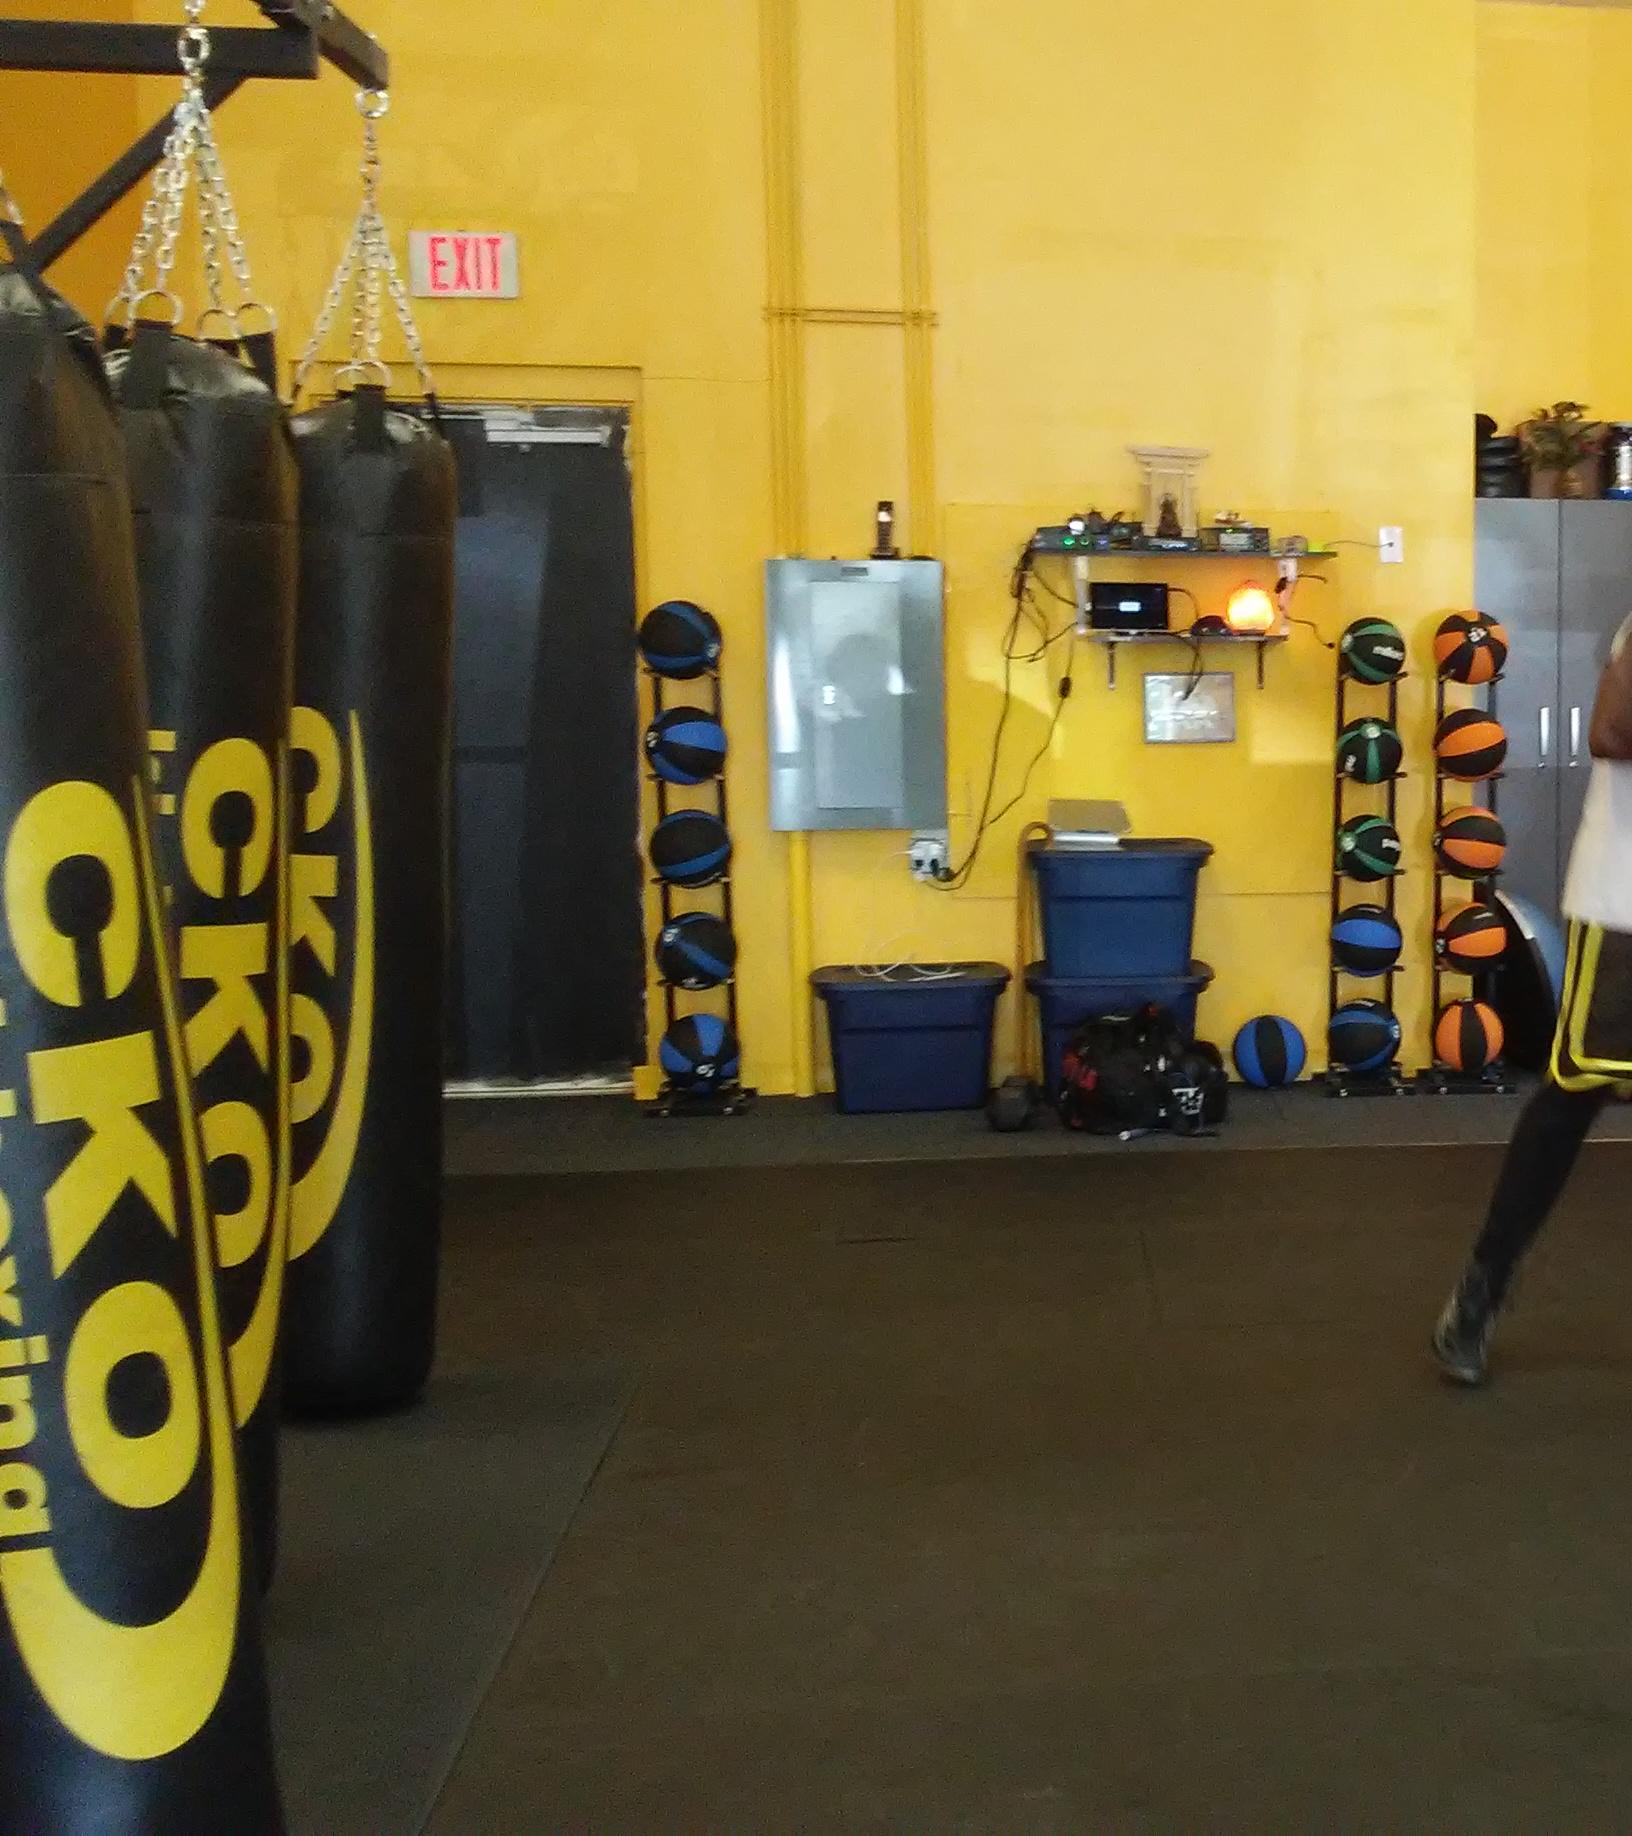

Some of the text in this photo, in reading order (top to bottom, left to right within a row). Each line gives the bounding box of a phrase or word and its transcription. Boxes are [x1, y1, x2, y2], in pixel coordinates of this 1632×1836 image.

[429, 235, 502, 291] EXIT
[5, 781, 201, 1508] CKO
[181, 738, 275, 1267] CKO
[289, 706, 343, 1124] CKO
